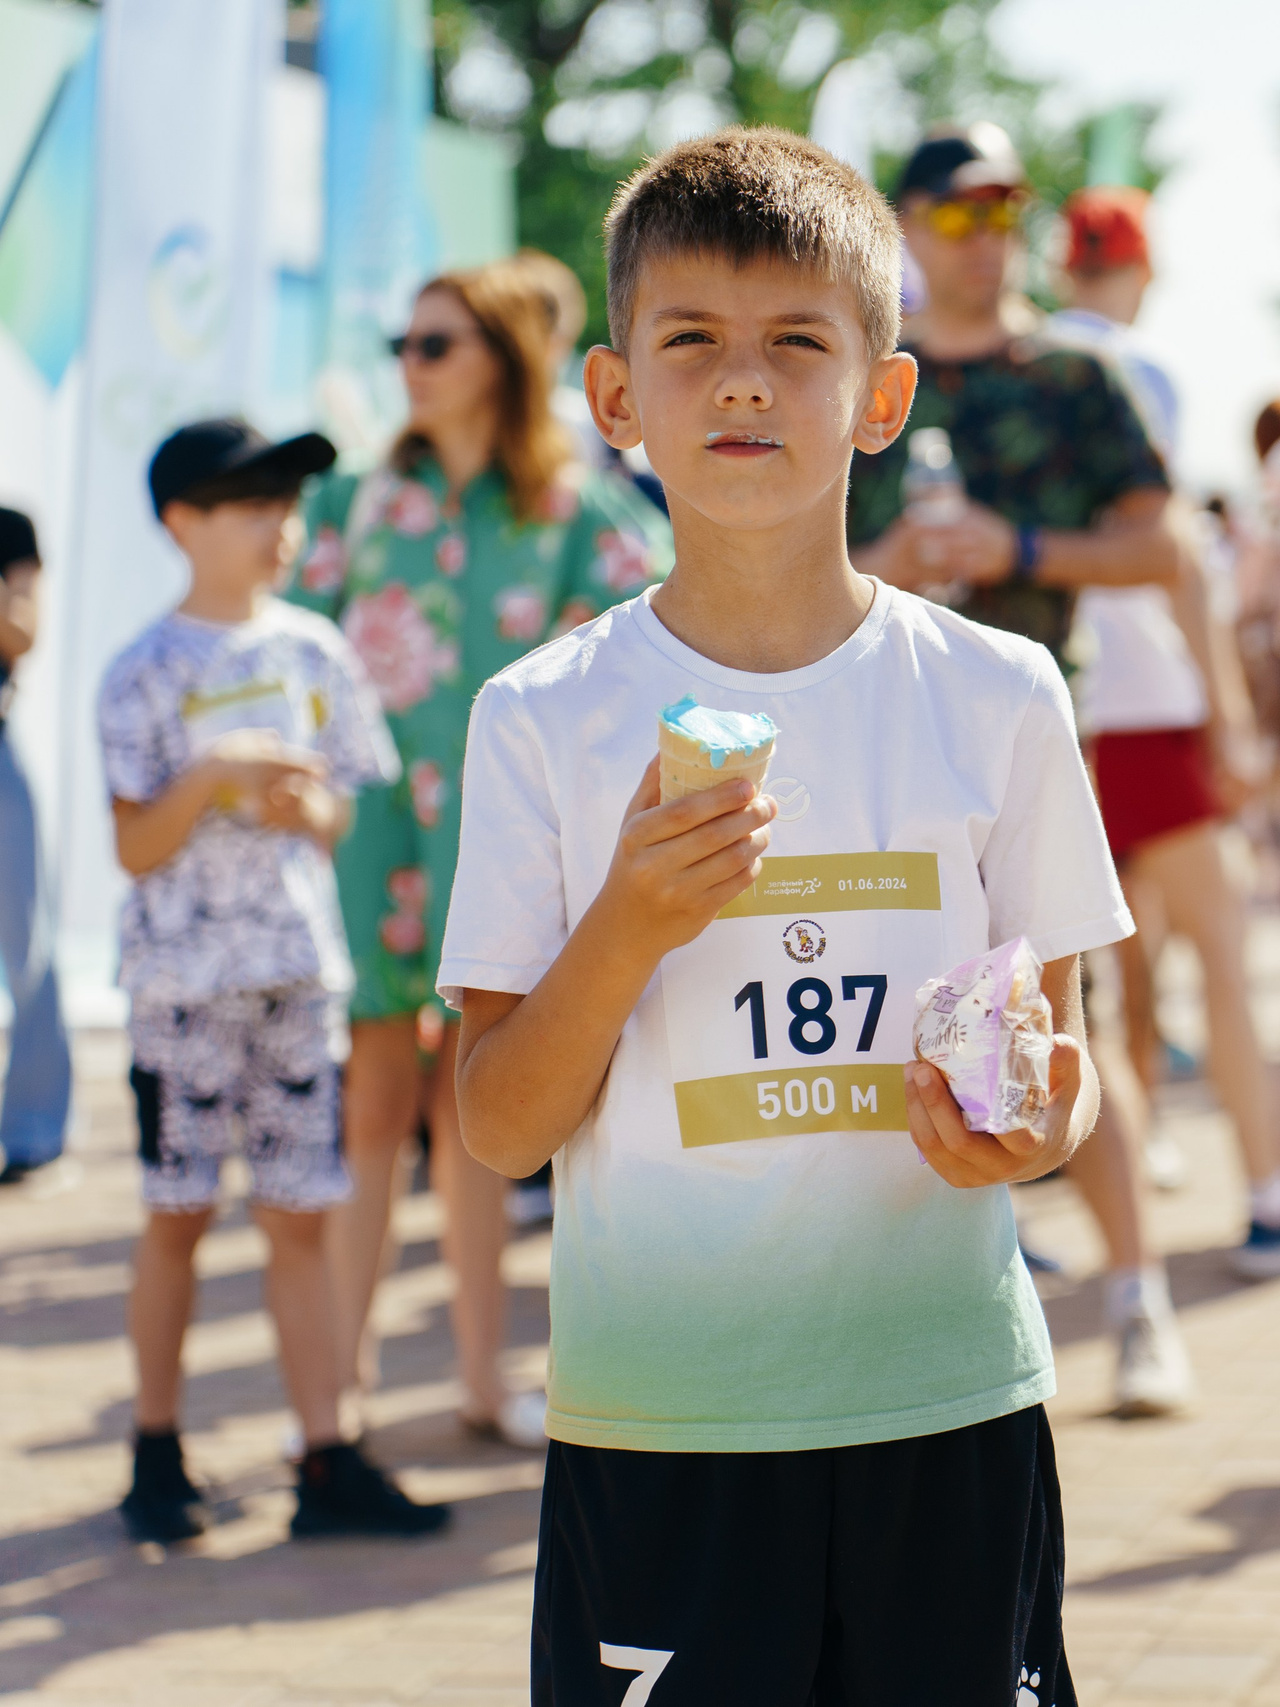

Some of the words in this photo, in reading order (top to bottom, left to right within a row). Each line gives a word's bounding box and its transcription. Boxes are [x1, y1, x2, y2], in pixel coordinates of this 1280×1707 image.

[763, 887, 801, 896] марафон
[768, 878, 803, 888] зелёный
[838, 877, 907, 891] 01.06.2024
[734, 974, 888, 1060] 187
[757, 1076, 836, 1121] 500
[599, 1641, 675, 1707] 7
